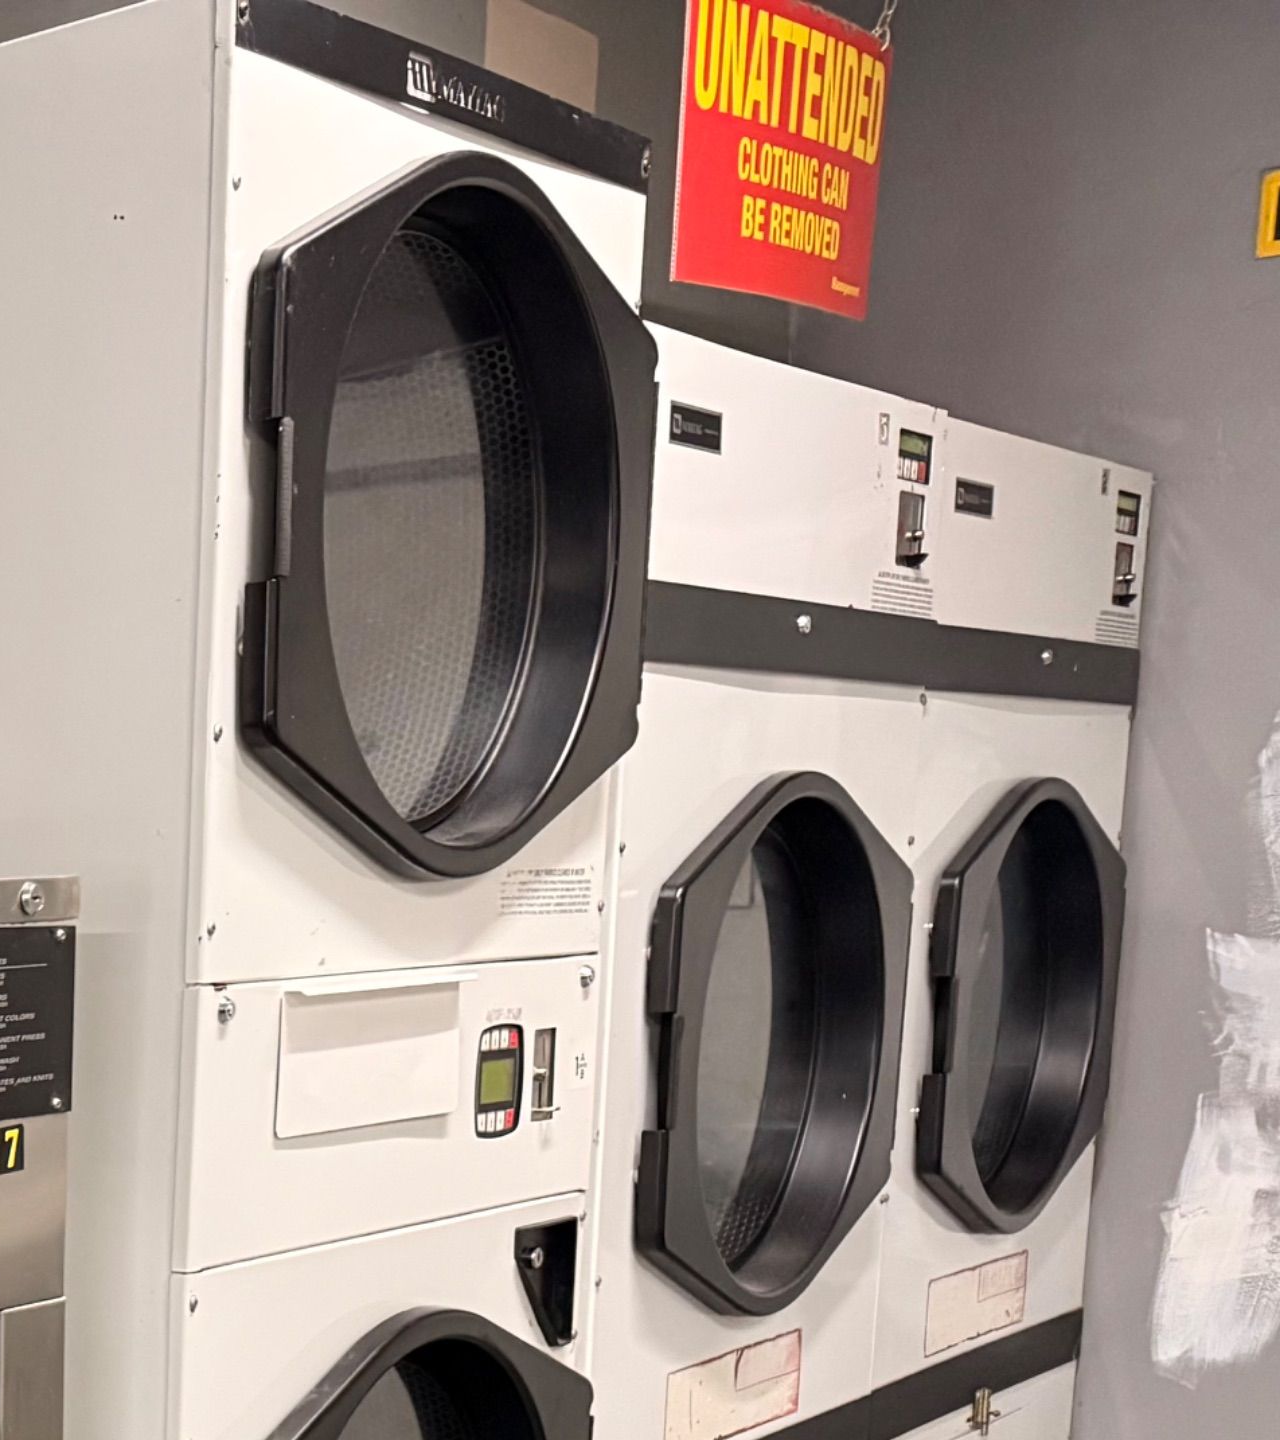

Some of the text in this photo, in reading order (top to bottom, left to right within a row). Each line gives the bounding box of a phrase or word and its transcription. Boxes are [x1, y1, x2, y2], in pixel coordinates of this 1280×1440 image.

[694, 0, 886, 165] UNATTENDED
[738, 136, 850, 211] CLOTHING CAN
[741, 195, 841, 262] BE REMOVED
[5, 1128, 19, 1168] 7
